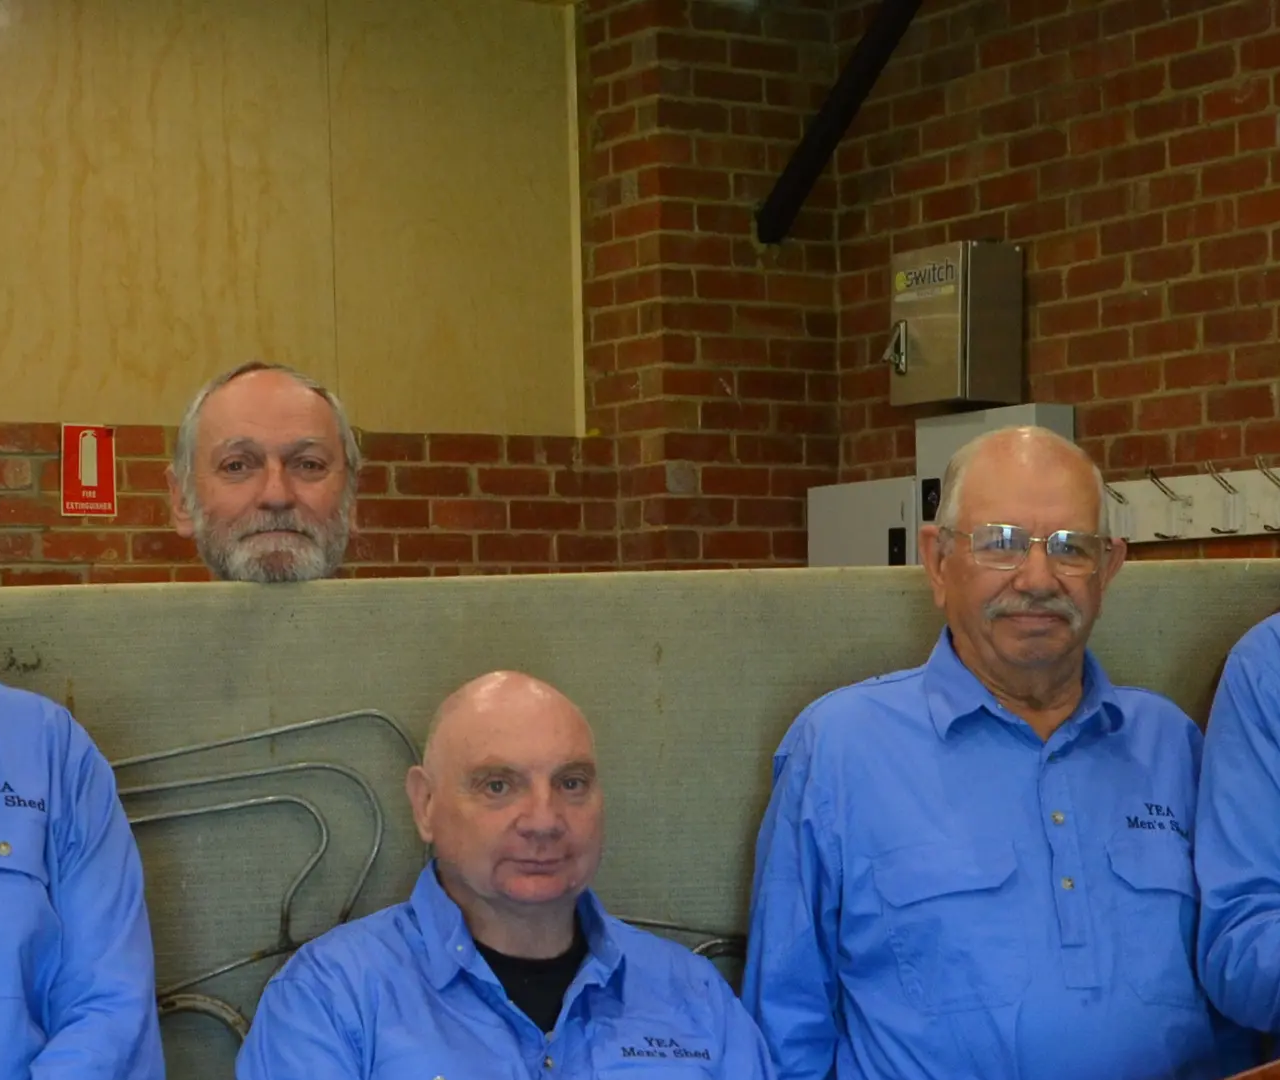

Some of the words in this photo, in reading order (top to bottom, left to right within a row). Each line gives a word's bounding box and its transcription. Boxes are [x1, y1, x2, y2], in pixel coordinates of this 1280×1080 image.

[82, 490, 96, 498] FIRE
[66, 502, 112, 510] EXTINGUISHER
[4, 795, 46, 812] Shed
[1143, 802, 1175, 818] YEA
[1126, 815, 1166, 830] Men's
[643, 1036, 680, 1048] YEA
[621, 1046, 667, 1058] Men's
[672, 1048, 711, 1061] Shed
